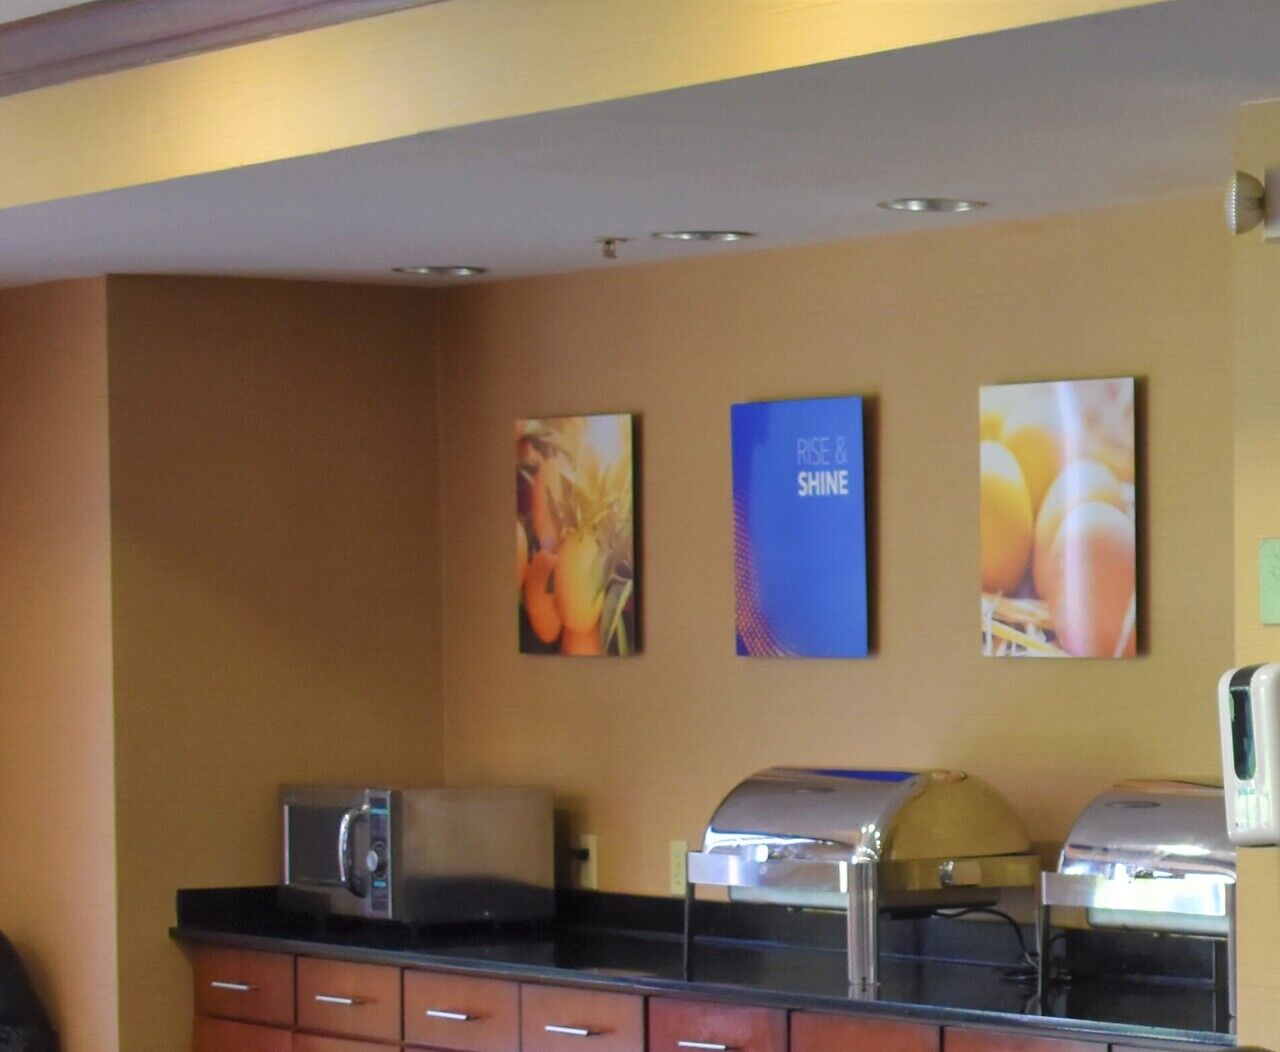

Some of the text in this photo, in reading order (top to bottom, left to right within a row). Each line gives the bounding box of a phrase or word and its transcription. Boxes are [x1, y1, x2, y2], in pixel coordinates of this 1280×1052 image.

[797, 436, 848, 466] RISE &
[798, 470, 849, 497] SHINE
